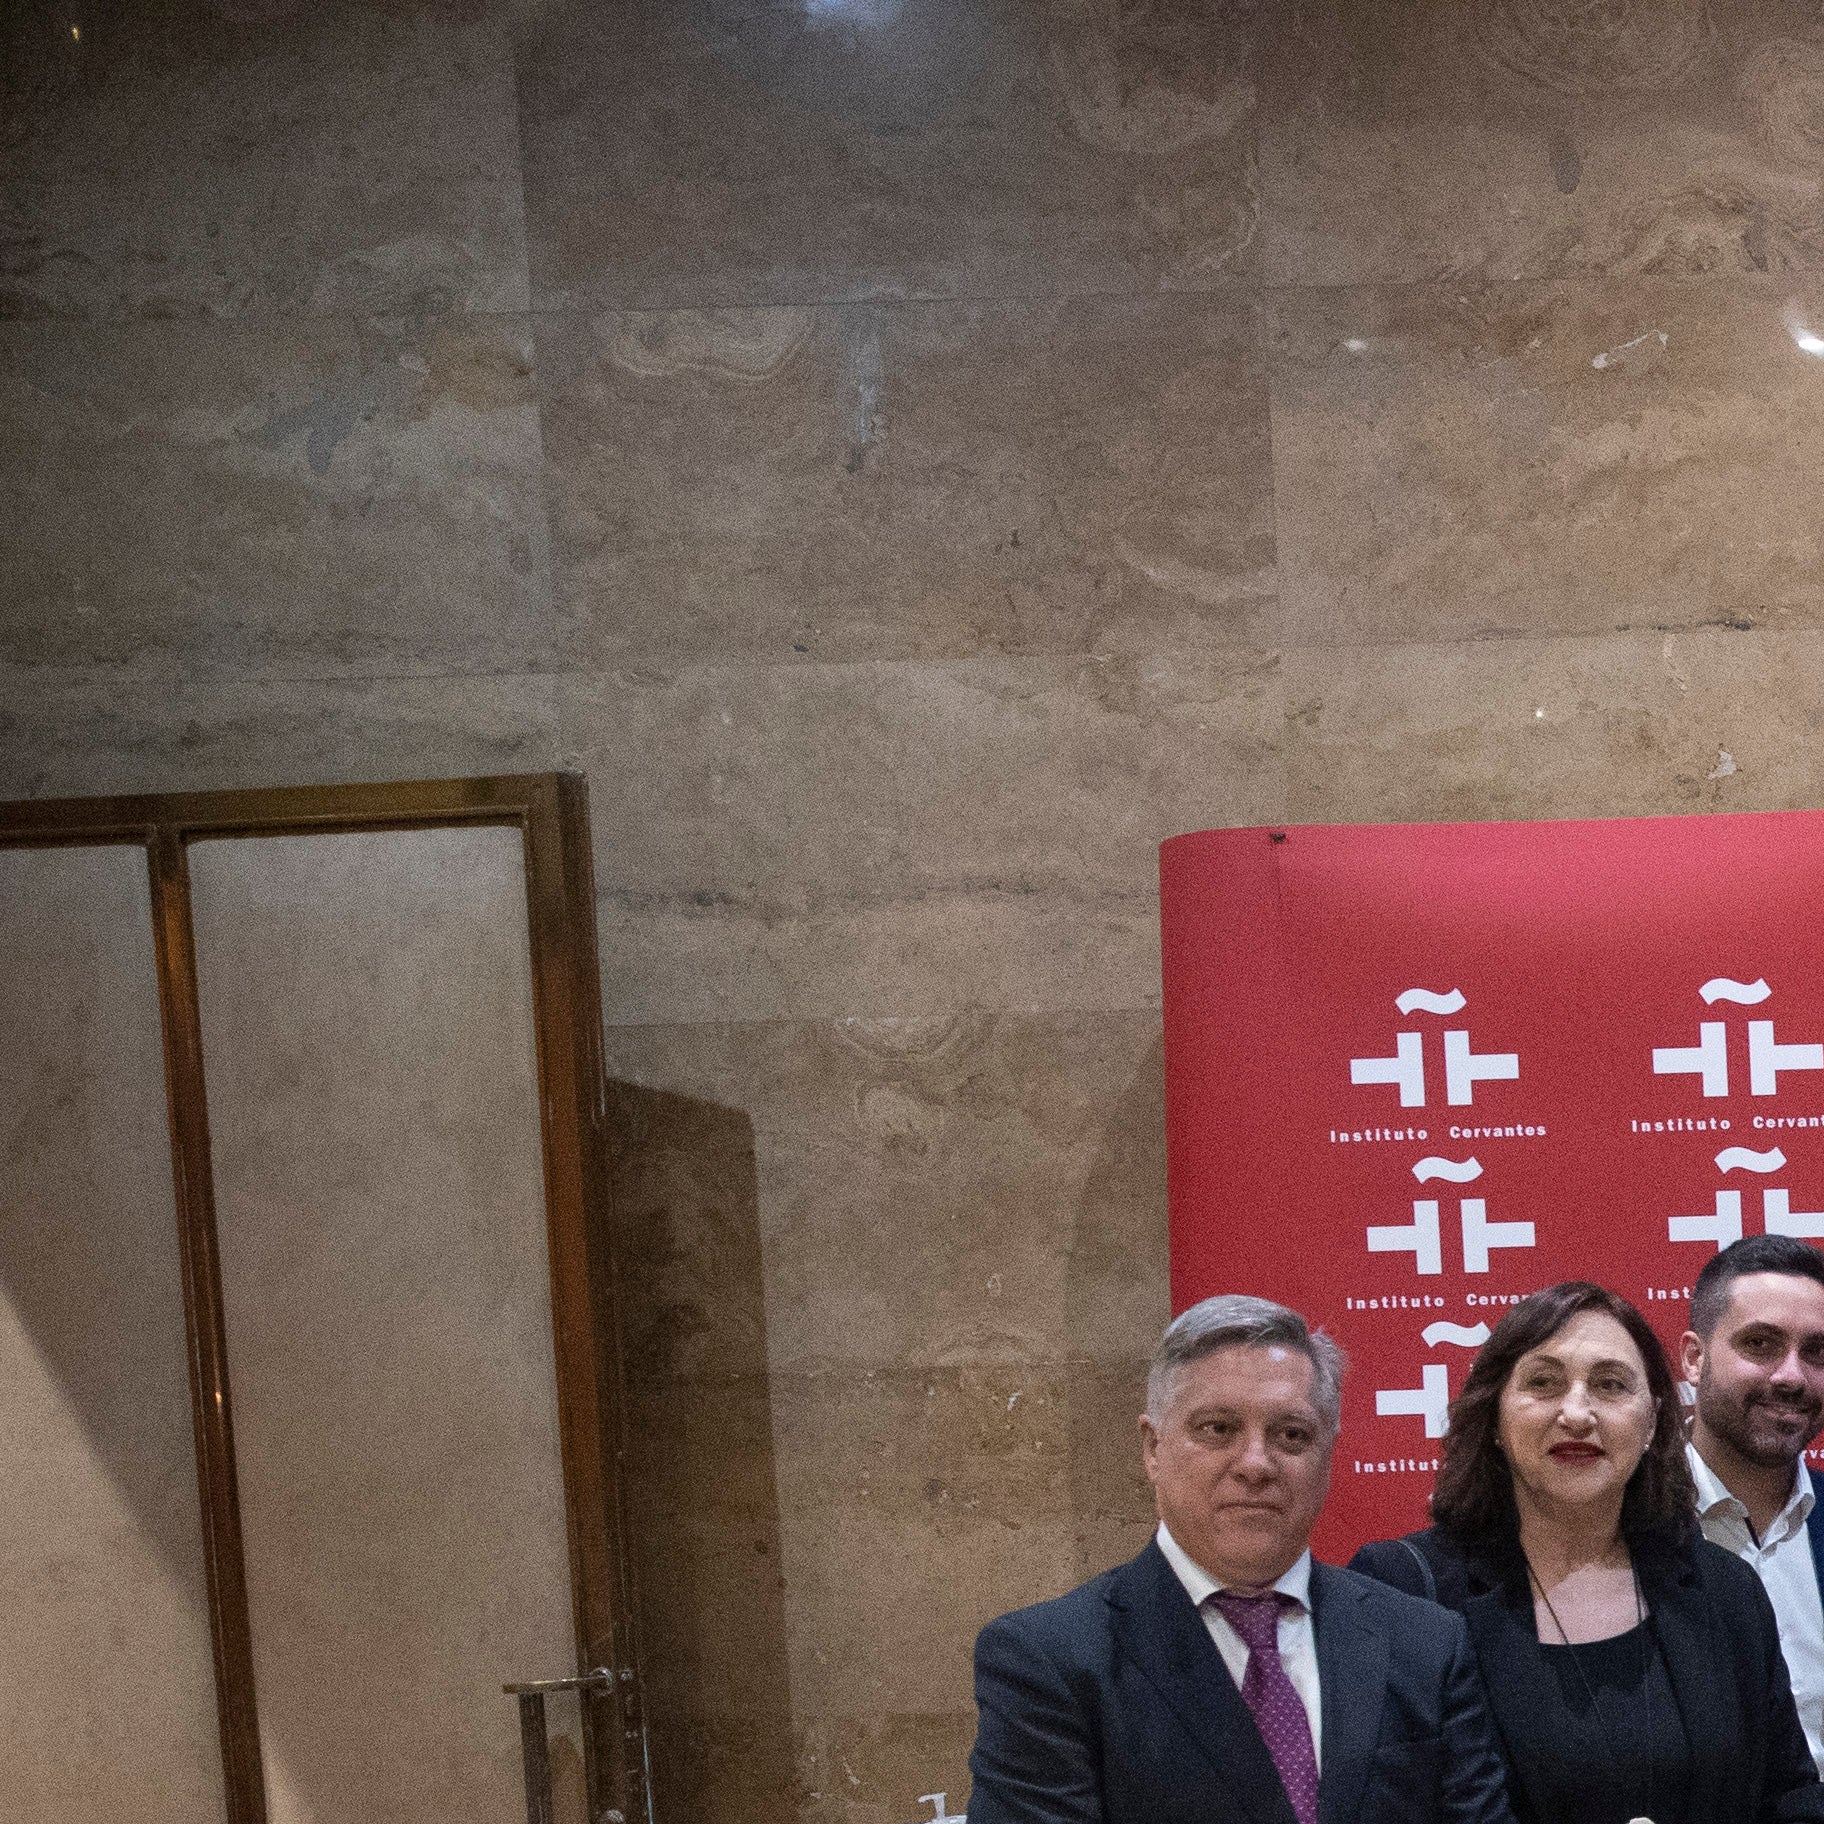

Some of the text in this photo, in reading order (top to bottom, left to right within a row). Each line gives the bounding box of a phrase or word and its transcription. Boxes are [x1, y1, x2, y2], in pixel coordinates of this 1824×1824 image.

[1631, 1117, 1731, 1133] Instituto
[1330, 1124, 1546, 1143] Instituto Cervantes
[1346, 1293, 1530, 1310] Instituto Cerva
[1354, 1459, 1446, 1473] Institut
